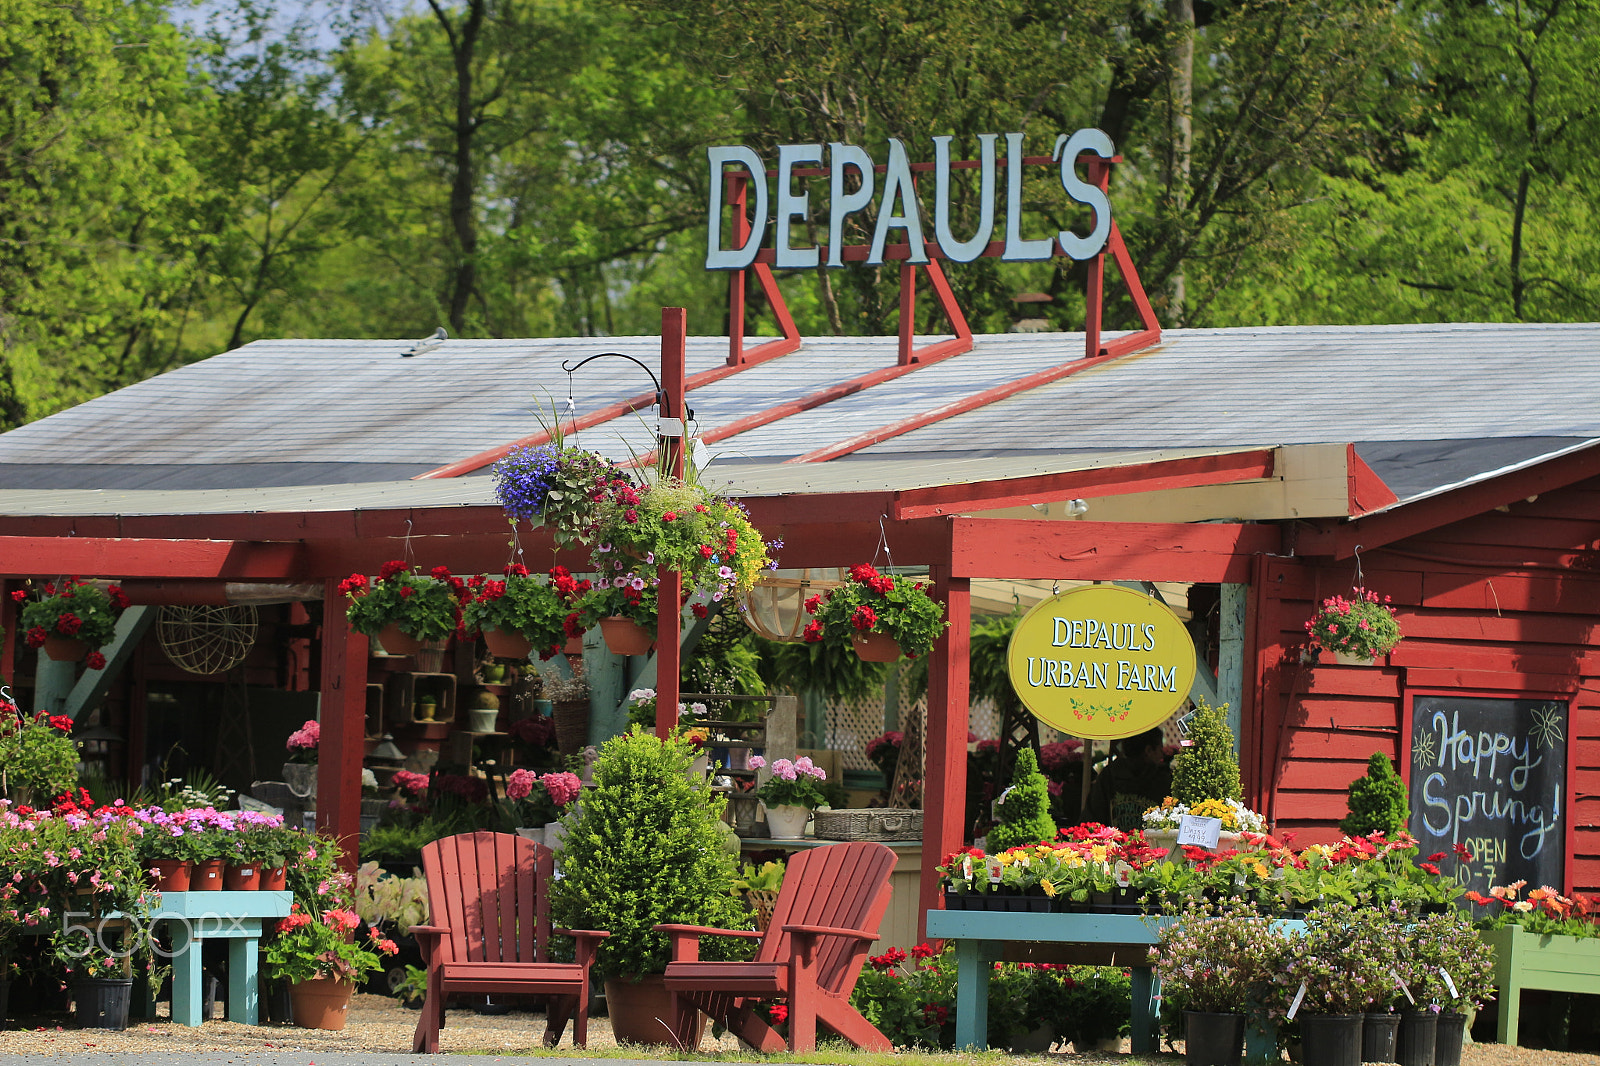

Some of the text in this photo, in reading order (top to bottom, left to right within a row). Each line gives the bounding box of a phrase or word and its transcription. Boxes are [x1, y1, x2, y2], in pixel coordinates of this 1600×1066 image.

[705, 128, 1116, 271] DEPAUL'S
[1052, 617, 1155, 651] DEPAUL'S
[1027, 657, 1177, 692] URBAN FARM
[1432, 710, 1542, 791] Happy
[1422, 771, 1560, 860] Spring!
[1464, 837, 1507, 864] OPEN
